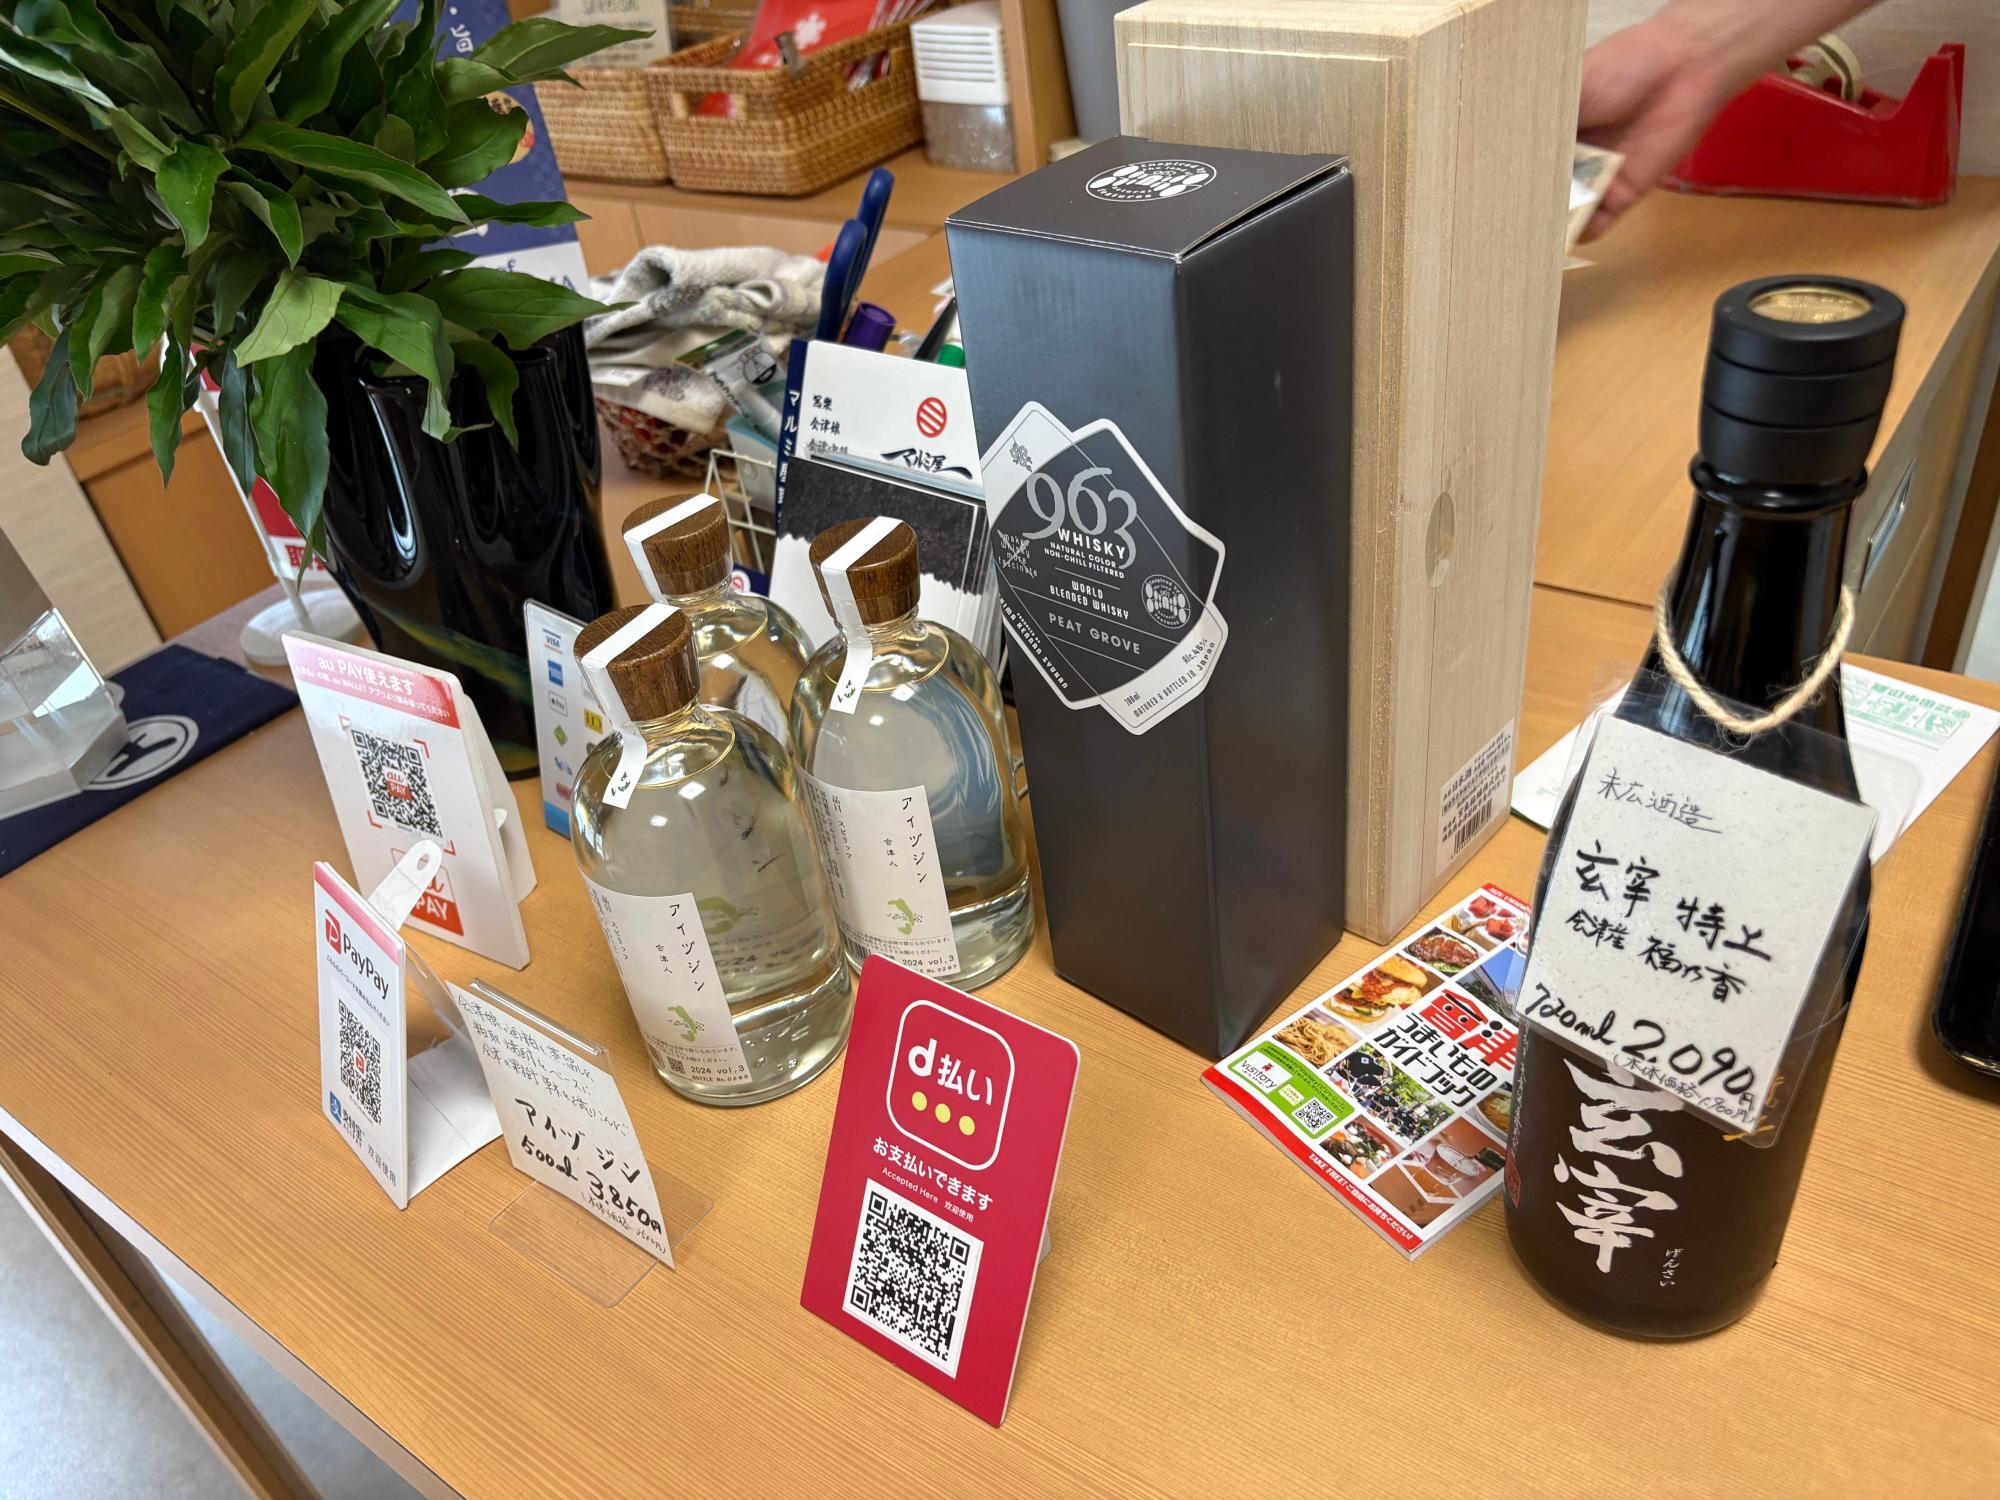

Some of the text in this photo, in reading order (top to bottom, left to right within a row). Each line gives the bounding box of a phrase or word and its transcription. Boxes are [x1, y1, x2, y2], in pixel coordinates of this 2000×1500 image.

[1022, 466, 1137, 569] 963
[1044, 548, 1125, 579] NON-CHILL FILTERED
[1050, 542, 1116, 568] NATURAL COLOR
[1057, 528, 1126, 559] WHISKY
[1050, 585, 1088, 606] BLENDED
[1093, 600, 1129, 620] WHISKY
[1072, 580, 1103, 599] WORLD
[546, 635, 561, 648] VISA
[1049, 612, 1140, 655] PEAT GROVE
[317, 657, 414, 695] au PAY使えます
[1133, 697, 1158, 718] MATURED
[1163, 676, 1188, 697] BOTTLED
[1197, 642, 1215, 671] JAPAN
[387, 771, 404, 783] au
[390, 783, 406, 795] PAY
[901, 797, 928, 884] アイヅジン
[668, 904, 705, 992] アイヅジン
[1676, 897, 1772, 963] 特上
[343, 933, 389, 1000] PayPay
[928, 954, 955, 966] vol.3
[1524, 982, 1618, 1047] 720ml
[690, 1064, 745, 1075] 2024 vol.3
[908, 1037, 994, 1106] d払い
[1373, 1026, 1477, 1107] ガイドブック
[1396, 1012, 1498, 1091] うまいもの
[872, 1135, 994, 1213] お支払いできます
[1309, 1153, 1326, 1170] TAKE
[1325, 1167, 1347, 1186] FREE!
[881, 1166, 974, 1223] Accepted Here 欢迎使用
[1659, 1248, 1684, 1288] げんさい
